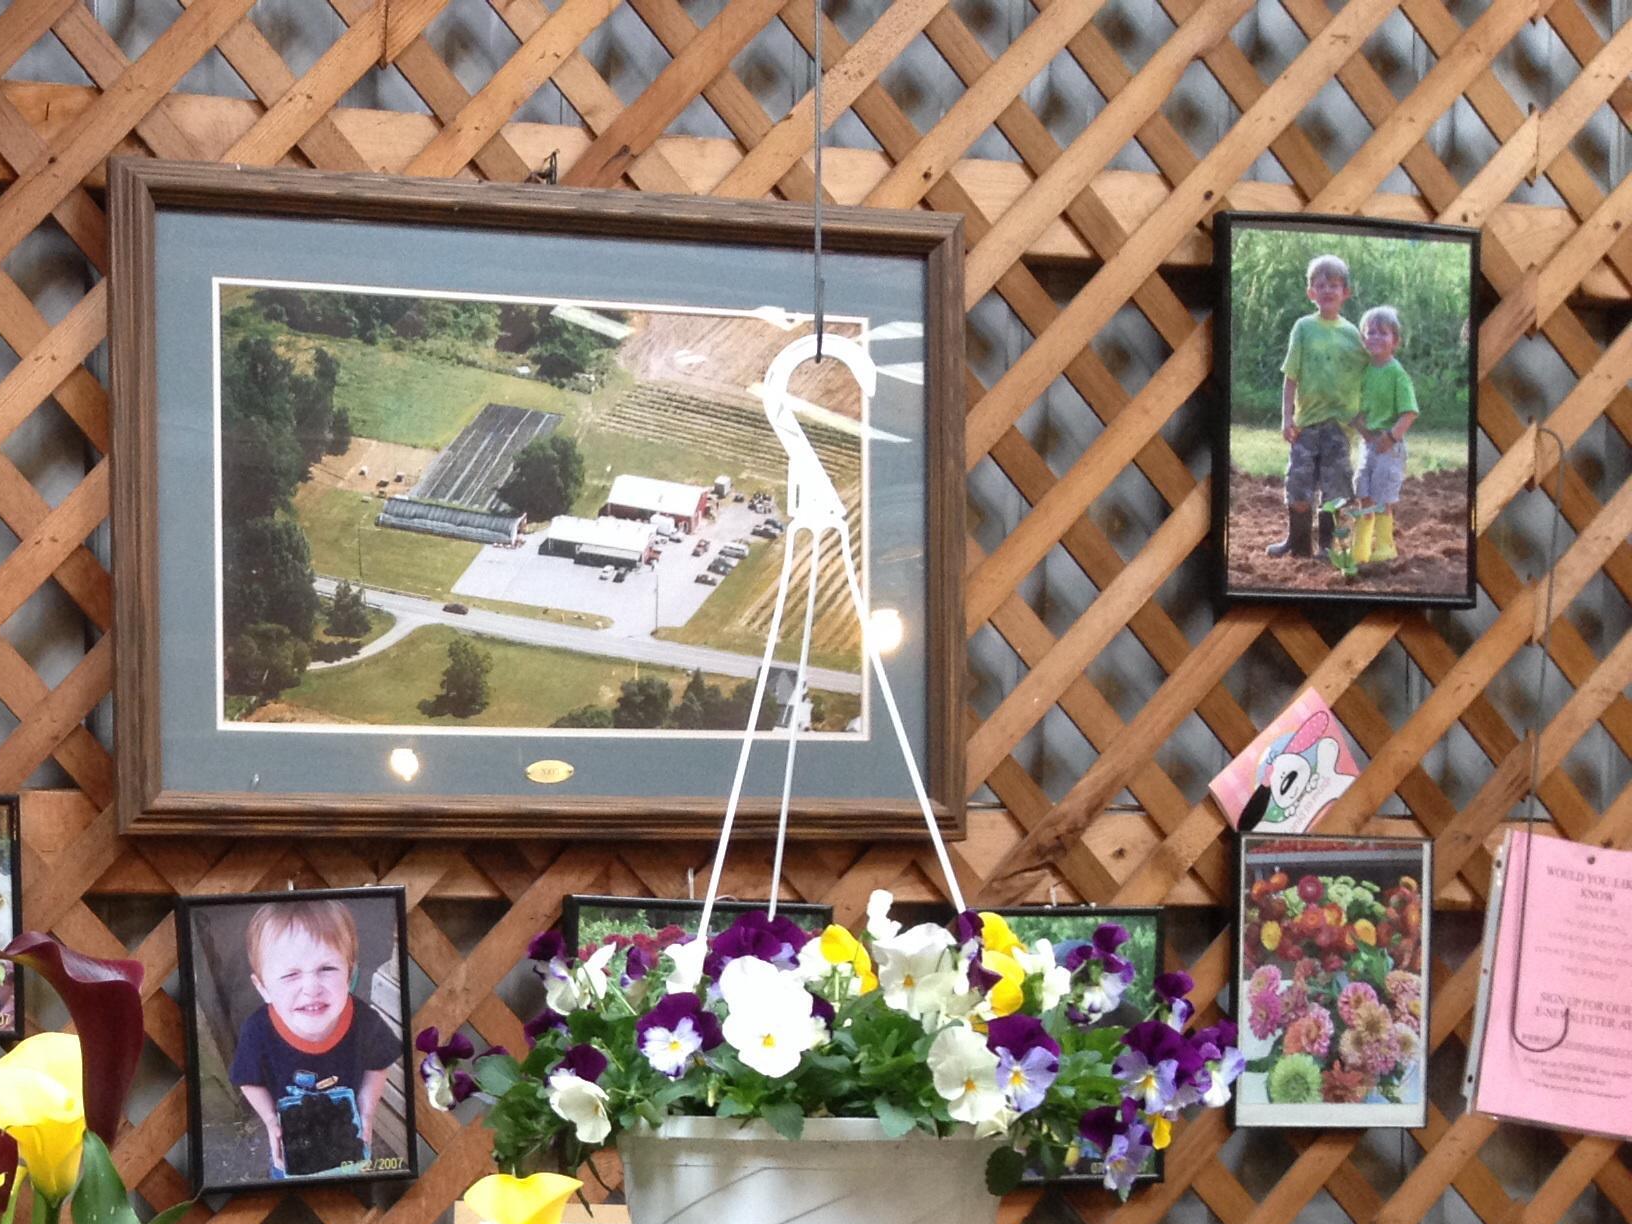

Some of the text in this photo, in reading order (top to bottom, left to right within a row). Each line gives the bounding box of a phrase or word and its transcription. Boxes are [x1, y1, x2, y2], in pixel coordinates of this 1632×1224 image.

[1546, 866, 1584, 882] WOULD
[1581, 888, 1614, 901] KNOW
[1541, 992, 1565, 1005] SIGN
